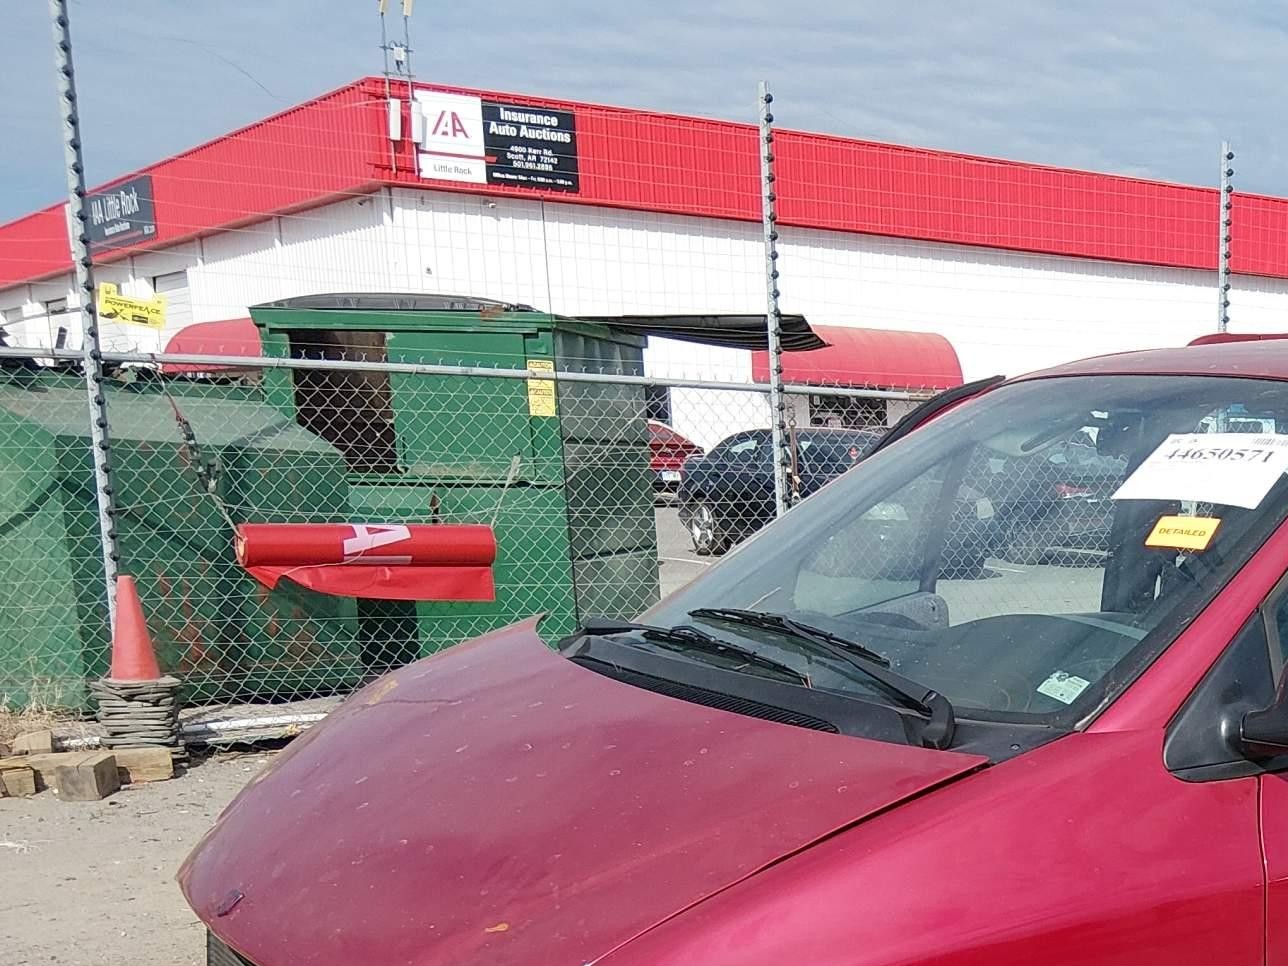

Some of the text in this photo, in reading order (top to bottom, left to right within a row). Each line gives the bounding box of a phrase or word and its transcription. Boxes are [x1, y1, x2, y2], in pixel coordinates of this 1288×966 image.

[499, 107, 559, 127] Insurance
[489, 121, 571, 143] Auto Auctions
[433, 164, 472, 176] Little Rock
[103, 194, 120, 222] Little
[120, 186, 139, 216] Rock
[1165, 448, 1275, 463] 44650571
[1158, 526, 1207, 537] DETAILED
